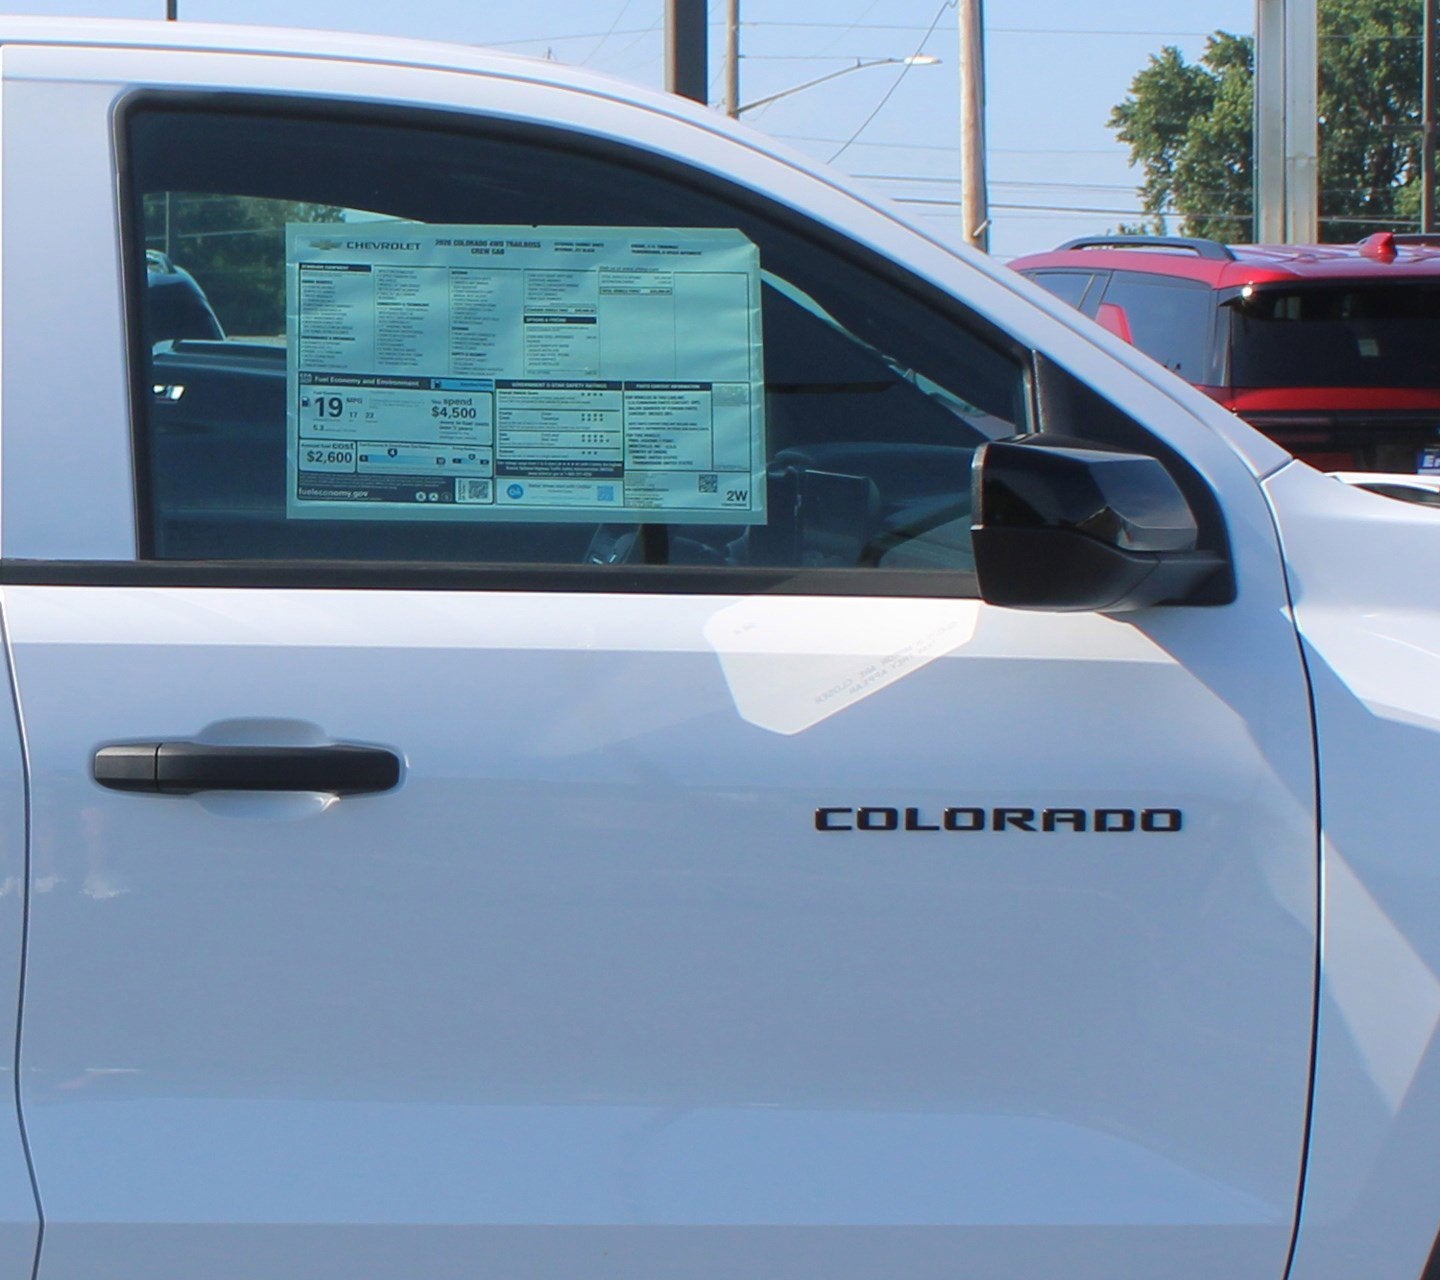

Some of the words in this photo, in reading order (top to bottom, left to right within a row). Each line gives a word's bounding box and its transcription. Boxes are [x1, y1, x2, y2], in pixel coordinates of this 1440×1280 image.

[346, 241, 421, 250] CHEVROLET
[315, 396, 343, 417] 19
[443, 398, 473, 406] spend
[431, 406, 476, 419] $4,500
[307, 450, 353, 464] $2,600
[298, 488, 369, 498] fueleconomy.gov
[726, 490, 748, 502] 2W
[814, 807, 1183, 832] COLORADO
